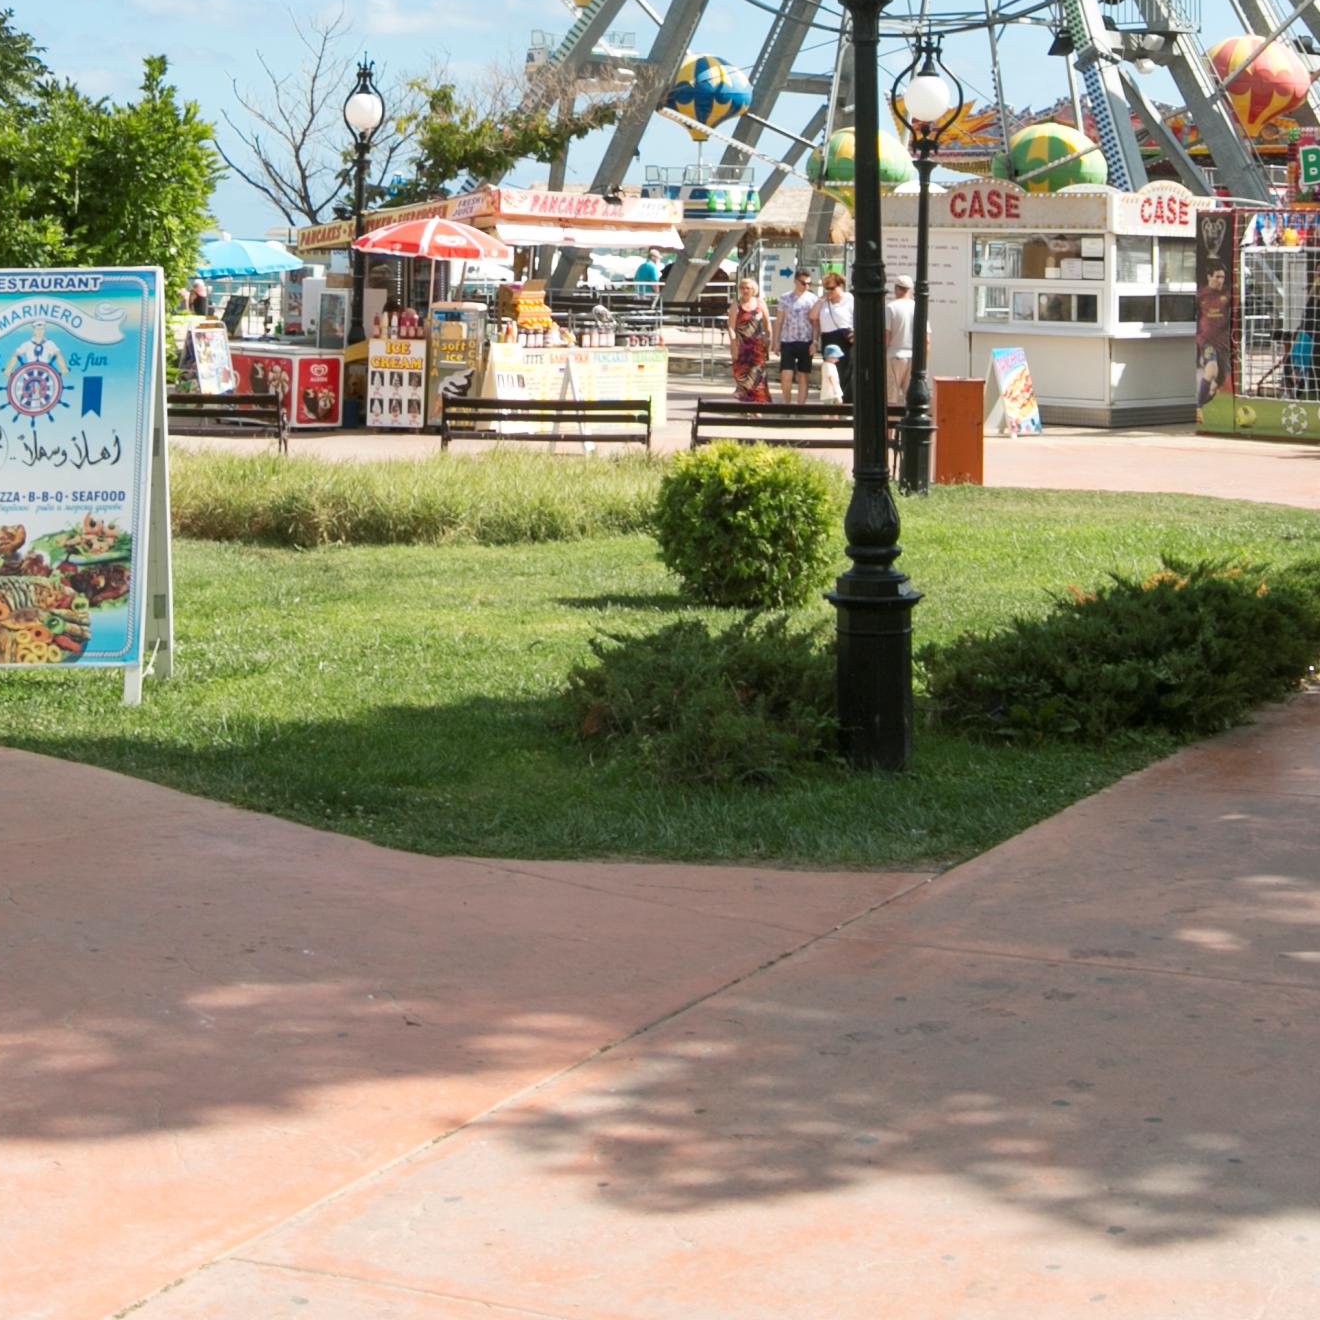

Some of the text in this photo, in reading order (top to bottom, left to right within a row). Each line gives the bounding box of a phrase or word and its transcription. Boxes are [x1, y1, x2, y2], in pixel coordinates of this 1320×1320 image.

[530, 193, 600, 217] PANCAKES
[948, 190, 1021, 220] CASE
[1140, 195, 1190, 225] CASE
[300, 224, 342, 247] PANCAKES
[386, 342, 411, 355] ICE
[441, 341, 466, 351] soft
[68, 353, 80, 366] &
[81, 353, 109, 373] fun
[371, 356, 423, 370] CREAM
[446, 352, 464, 361] ice
[29, 491, 64, 503] B-B-Q
[71, 490, 126, 502] SEAFOOD
